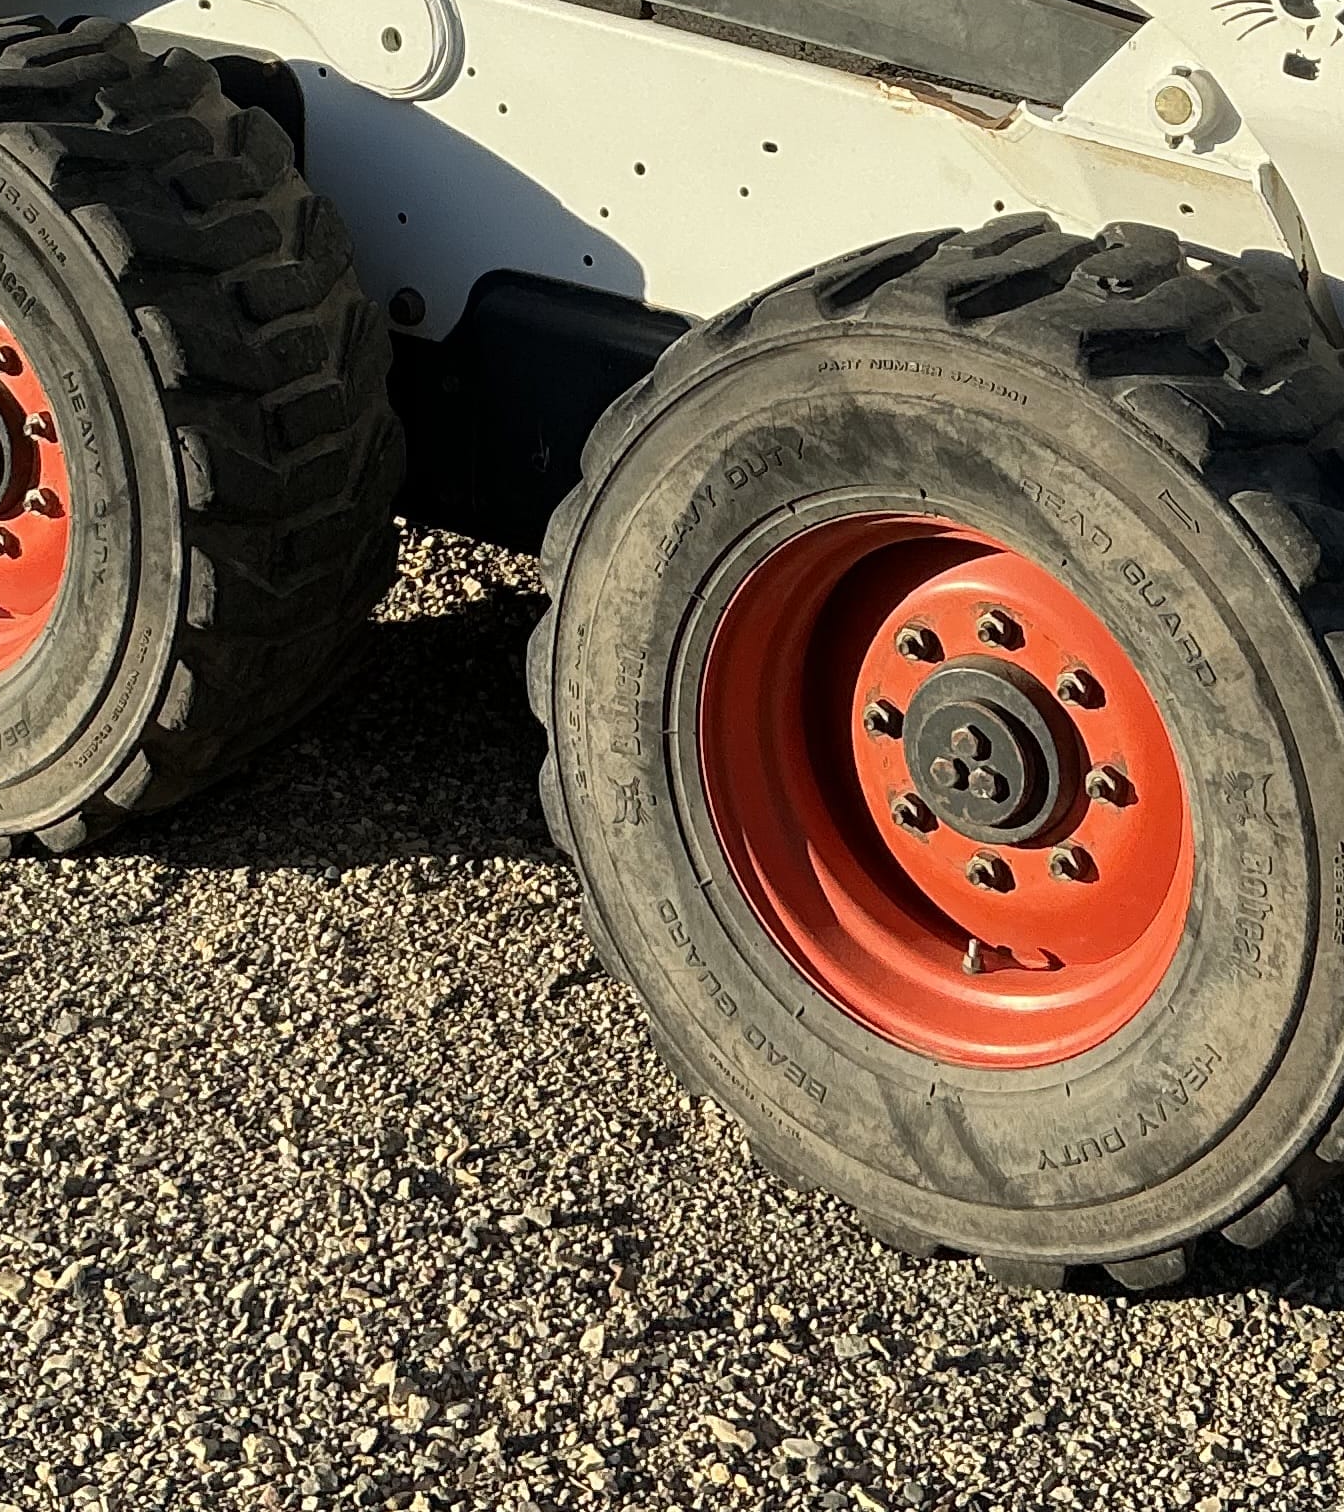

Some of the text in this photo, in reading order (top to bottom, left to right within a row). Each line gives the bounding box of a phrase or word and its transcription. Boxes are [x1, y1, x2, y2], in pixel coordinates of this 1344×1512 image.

[61, 369, 111, 586] HEAVY DUTY
[654, 437, 808, 580] HEAVY DUTY
[1018, 473, 1218, 690] BEAD GUARD
[658, 897, 738, 1019] GUARD
[743, 1026, 828, 1104] BEAD
[1138, 1041, 1224, 1139] HEAVY
[1036, 1128, 1127, 1172] DUTY
